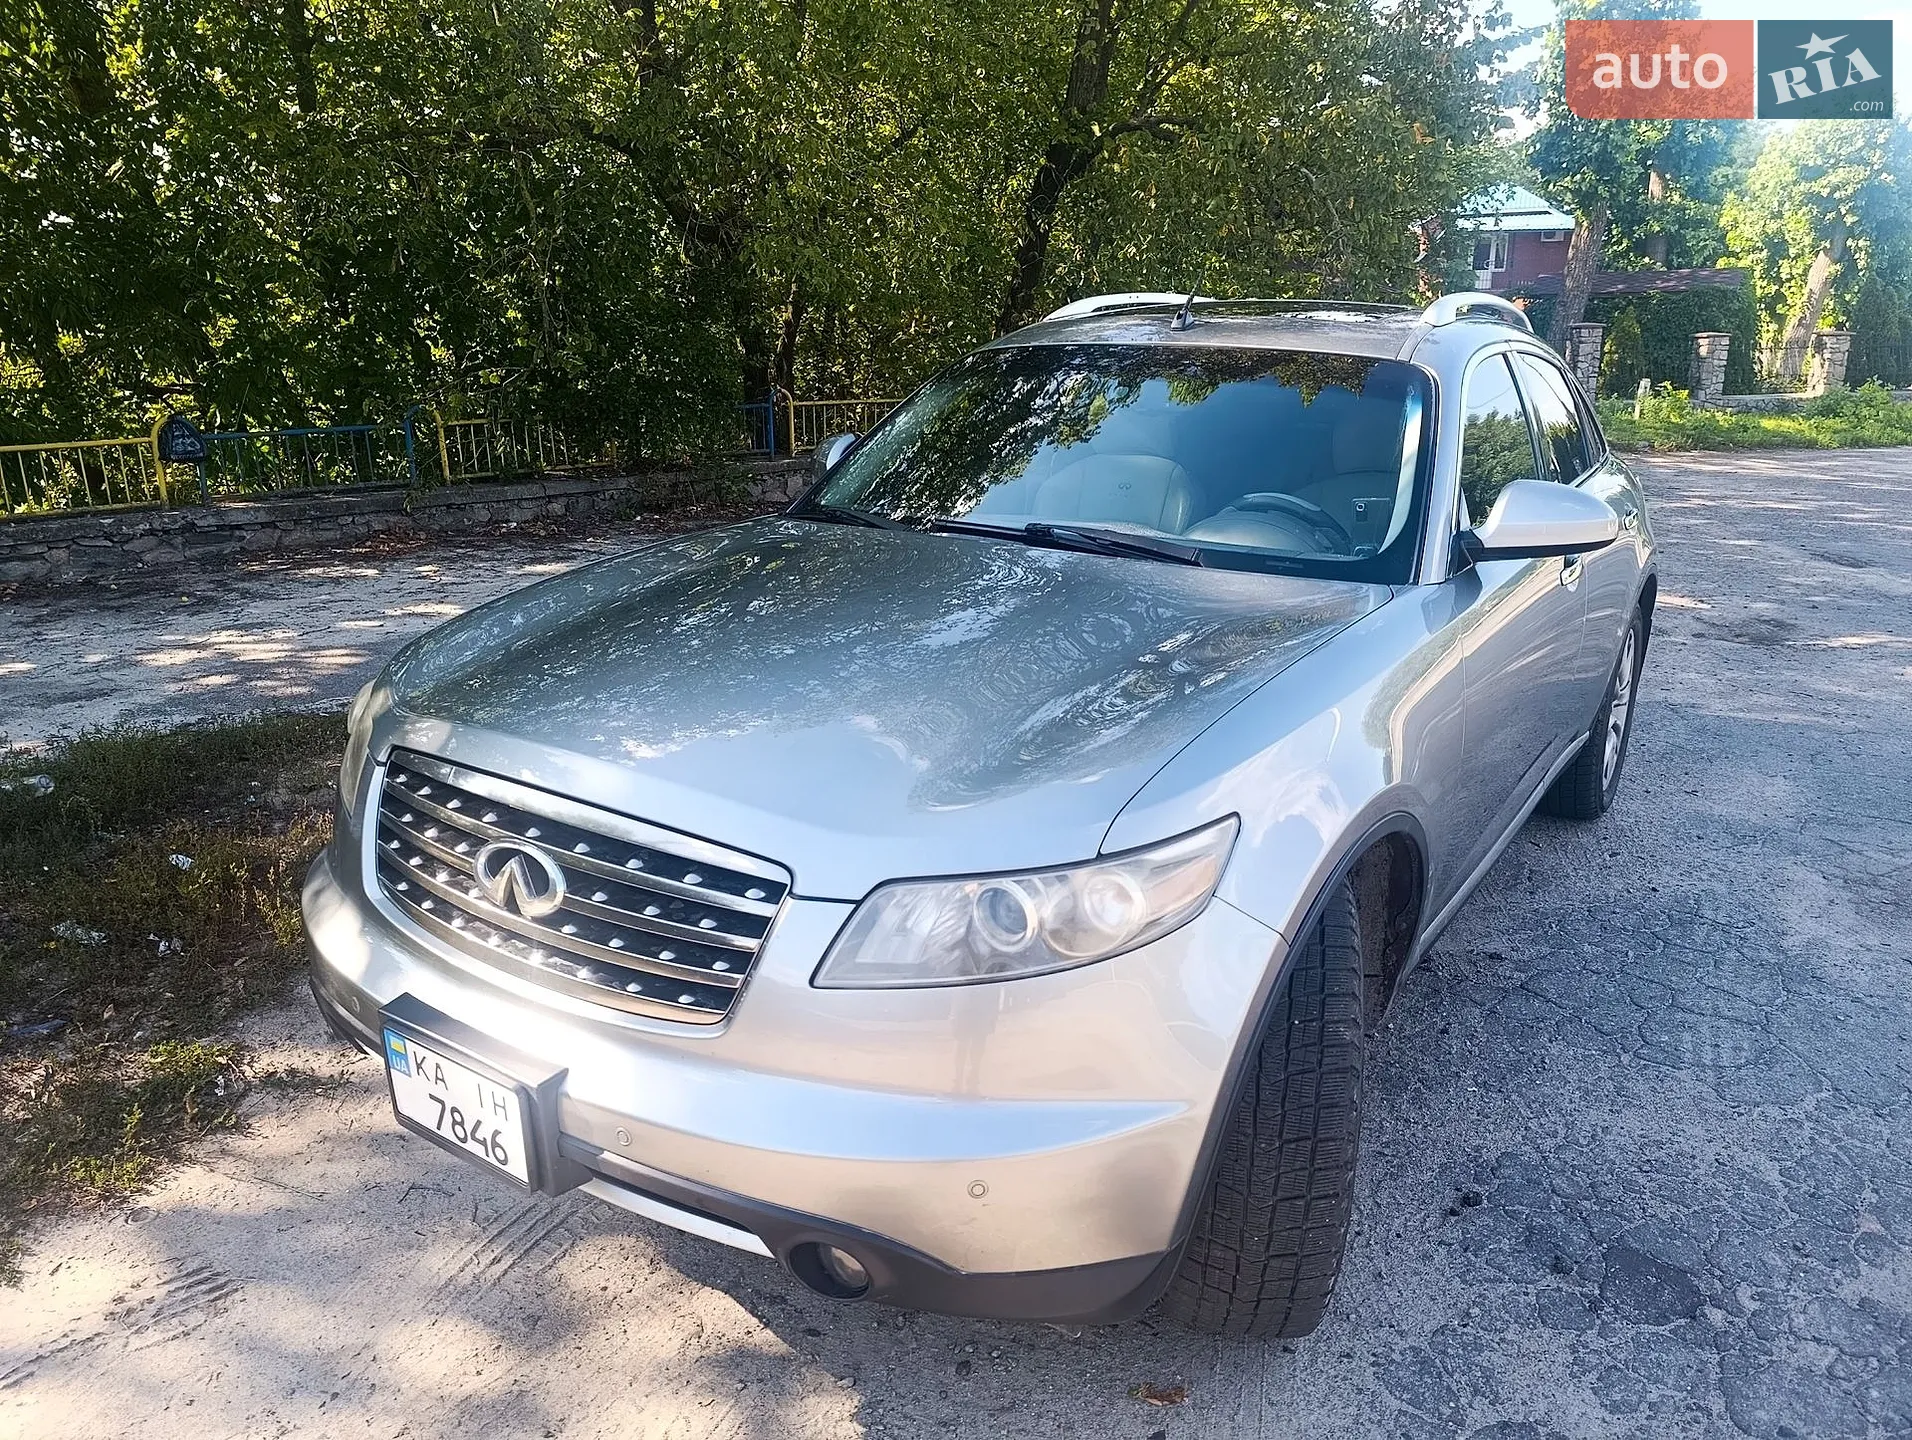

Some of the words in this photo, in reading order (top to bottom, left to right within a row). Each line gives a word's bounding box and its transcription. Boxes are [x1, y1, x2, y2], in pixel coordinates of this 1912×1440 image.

[393, 1056, 409, 1074] UA
[413, 1051, 449, 1091] KA
[477, 1083, 508, 1121] IH
[428, 1093, 509, 1166] 7846
